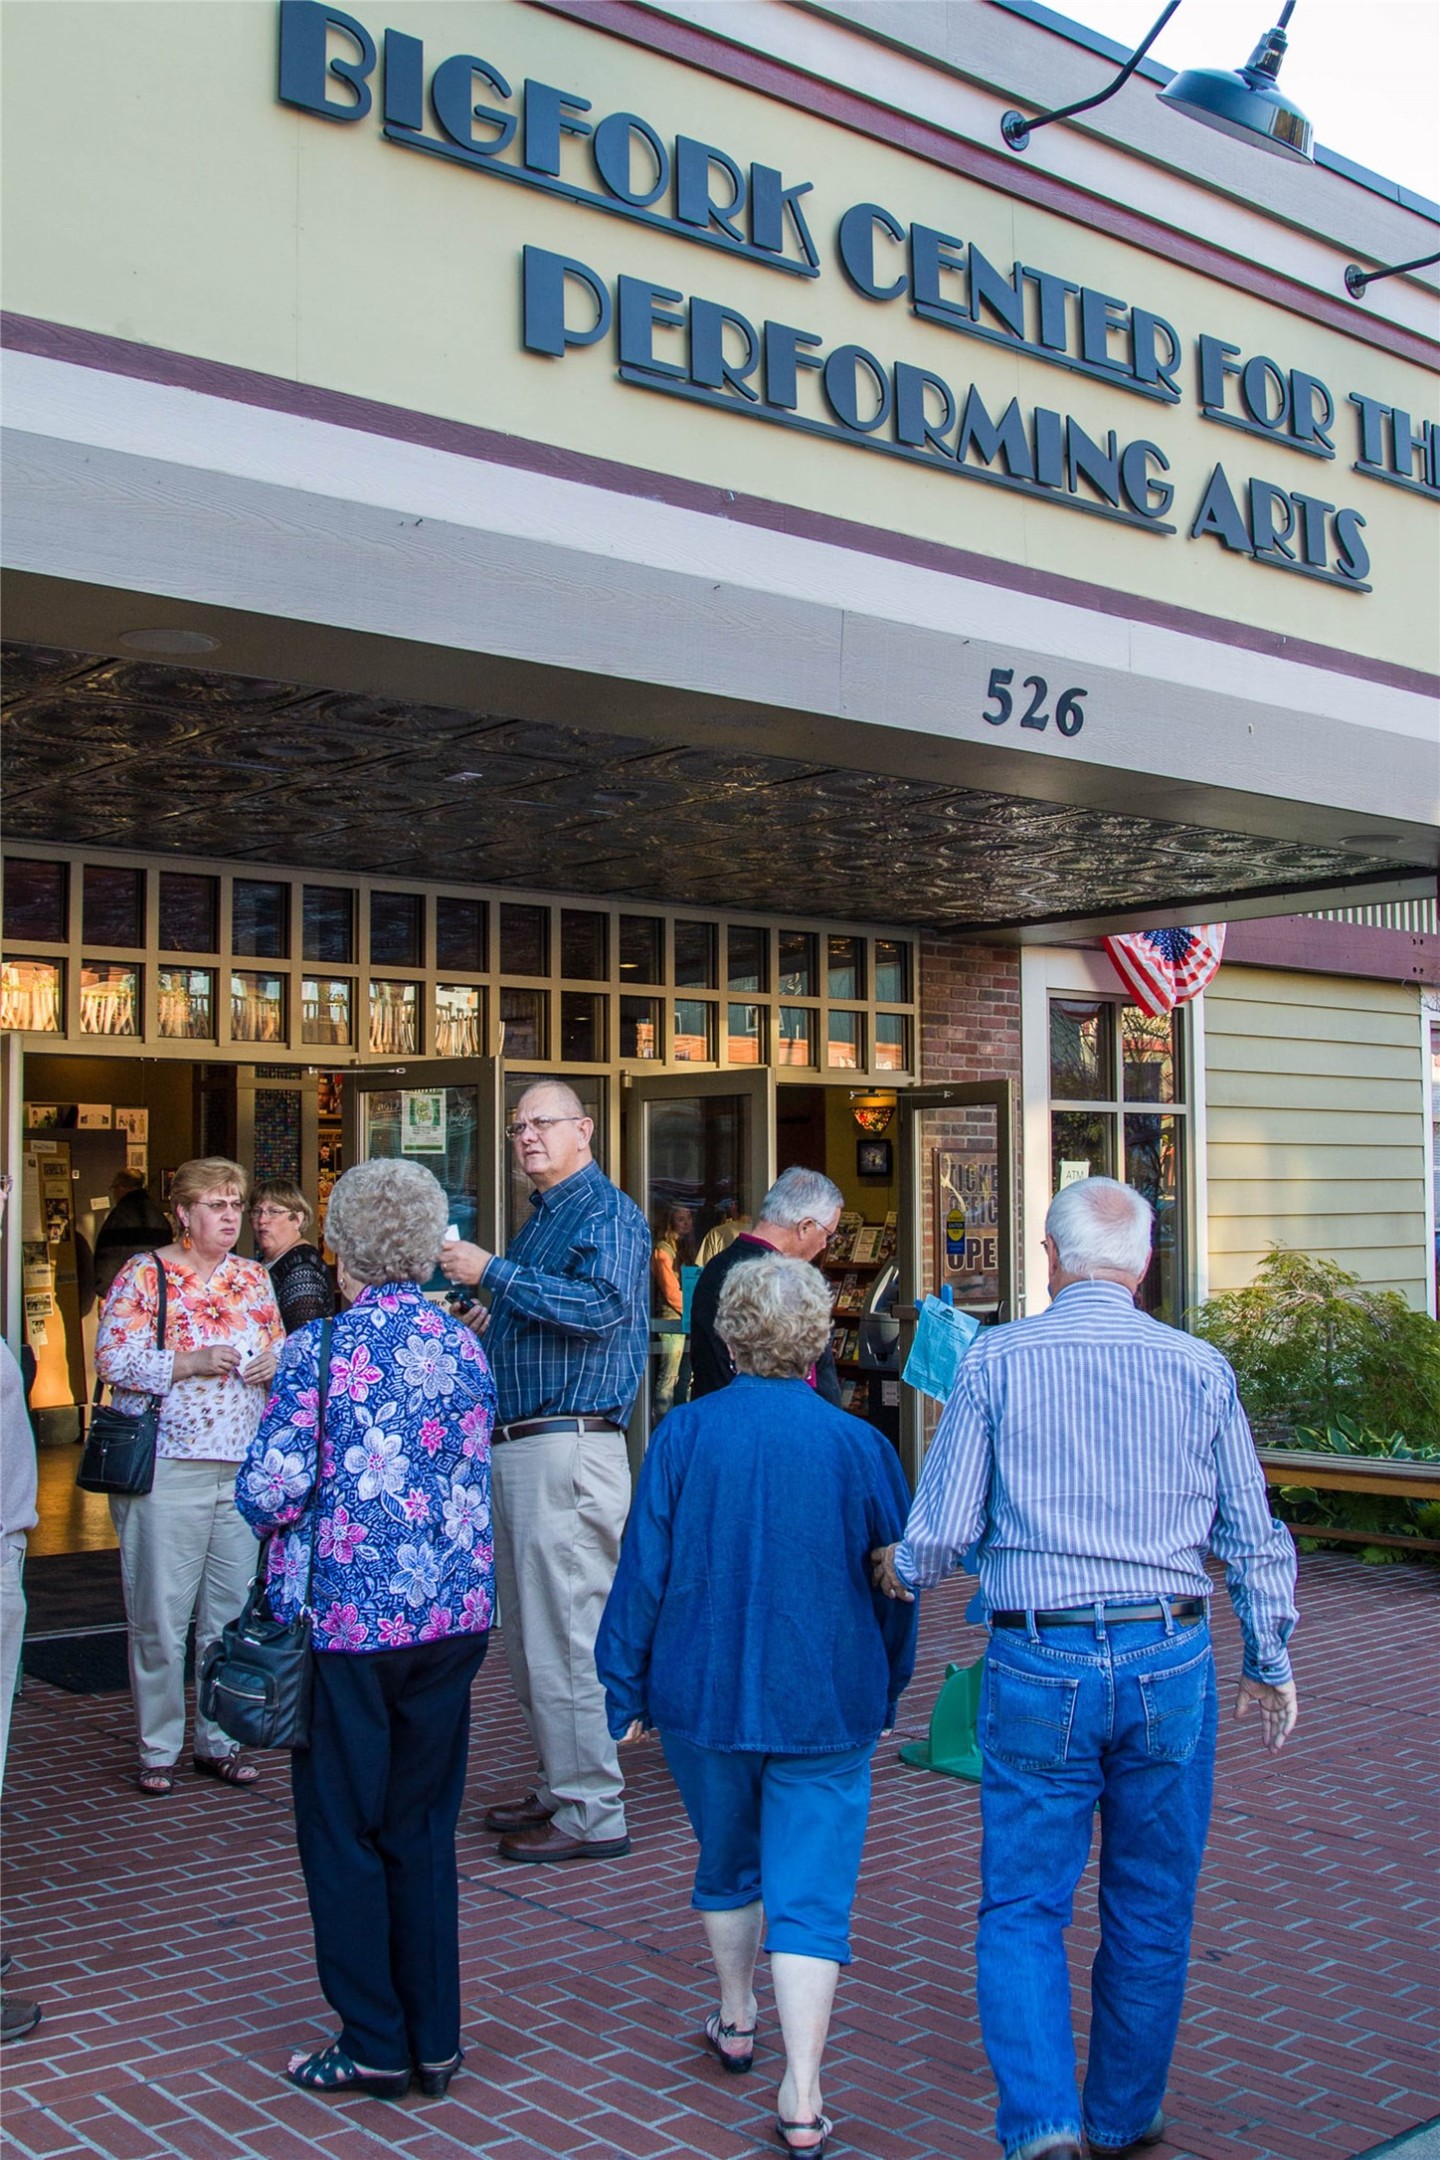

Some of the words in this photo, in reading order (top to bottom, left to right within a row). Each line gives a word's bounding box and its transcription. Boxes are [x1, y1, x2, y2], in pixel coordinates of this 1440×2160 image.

[279, 0, 821, 270] BIGFORK
[838, 202, 1183, 397] CENTER
[1199, 333, 1336, 453] FOR
[1349, 391, 1440, 492] TH
[522, 244, 1175, 520] PERFORMING
[1191, 462, 1371, 582] ARTS
[982, 668, 1089, 737] 526
[1066, 1170, 1084, 1180] ATM
